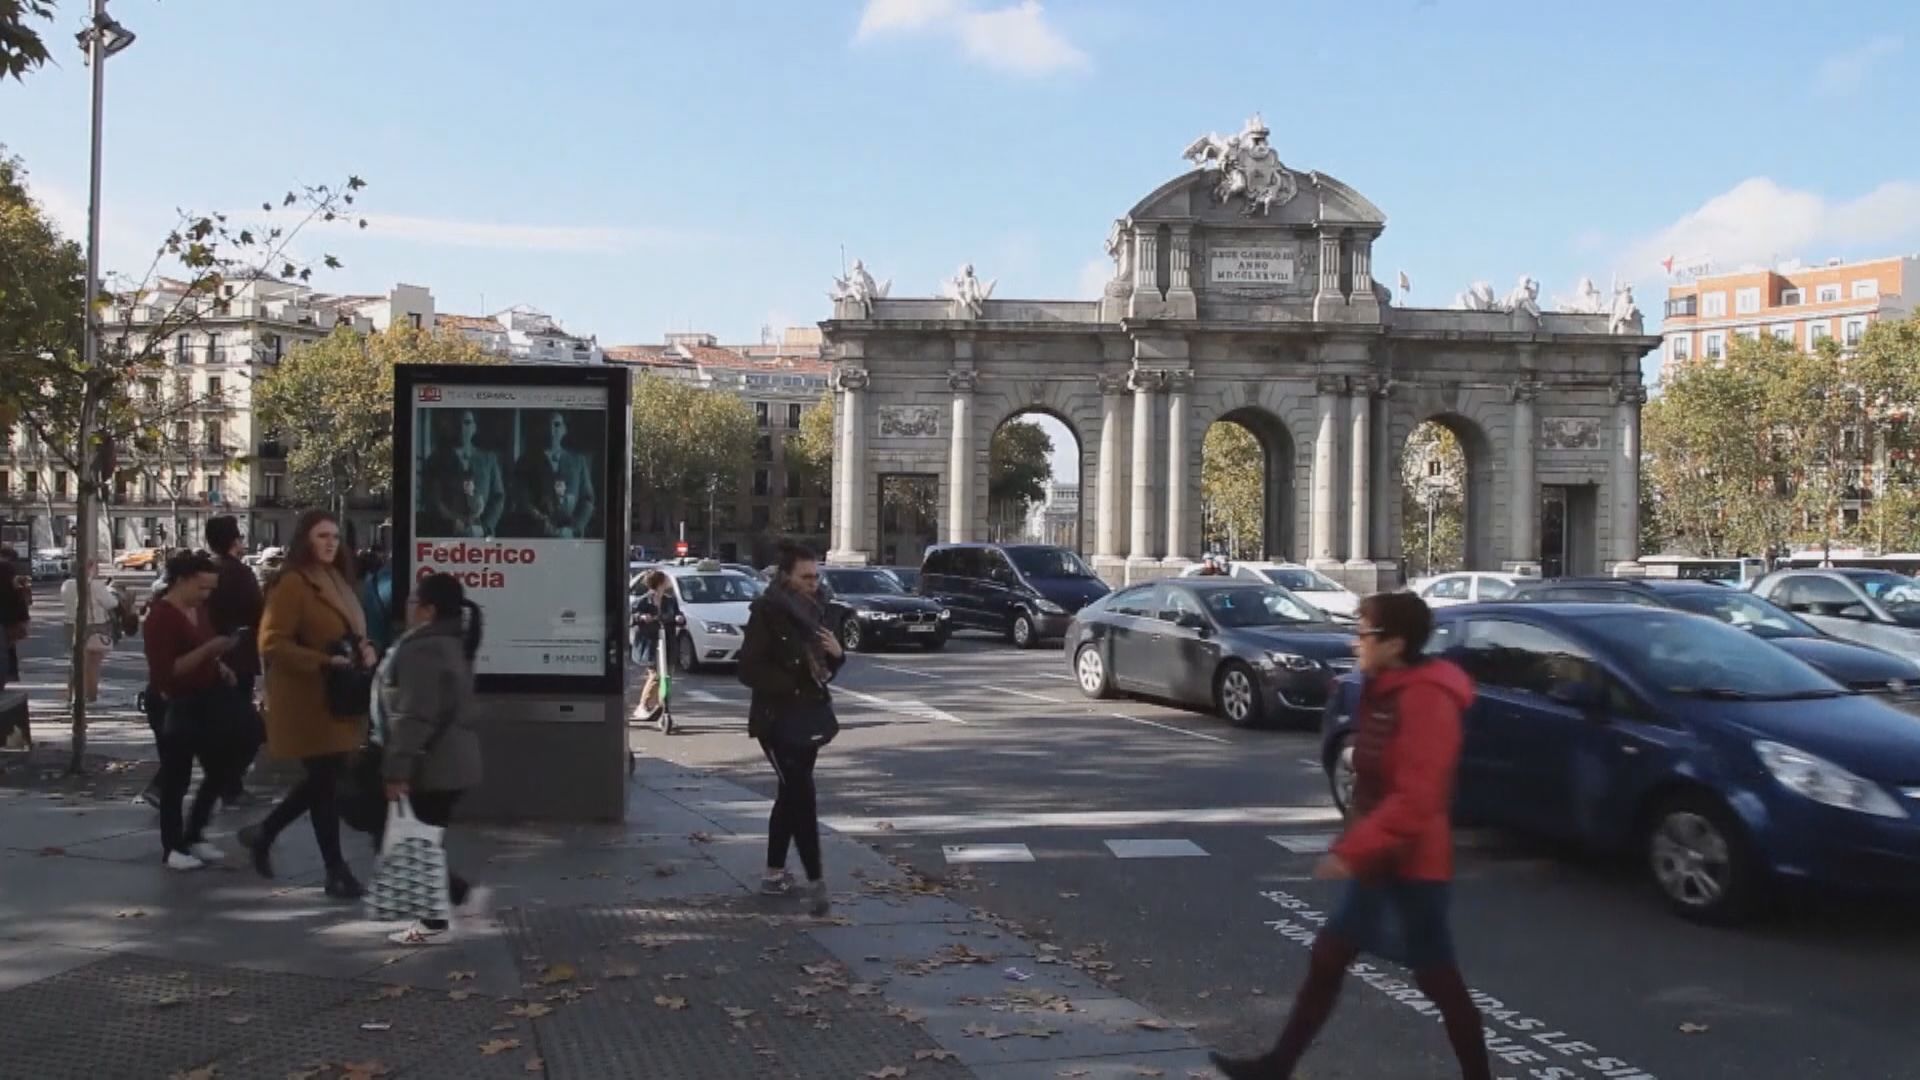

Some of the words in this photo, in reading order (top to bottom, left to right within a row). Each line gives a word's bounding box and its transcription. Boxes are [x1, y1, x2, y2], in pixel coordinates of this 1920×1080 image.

[1238, 261, 1269, 271] ANNO
[416, 542, 536, 564] Federico
[416, 566, 505, 588] Grcía
[555, 654, 598, 664] MADRID
[1530, 1031, 1598, 1056] LE
